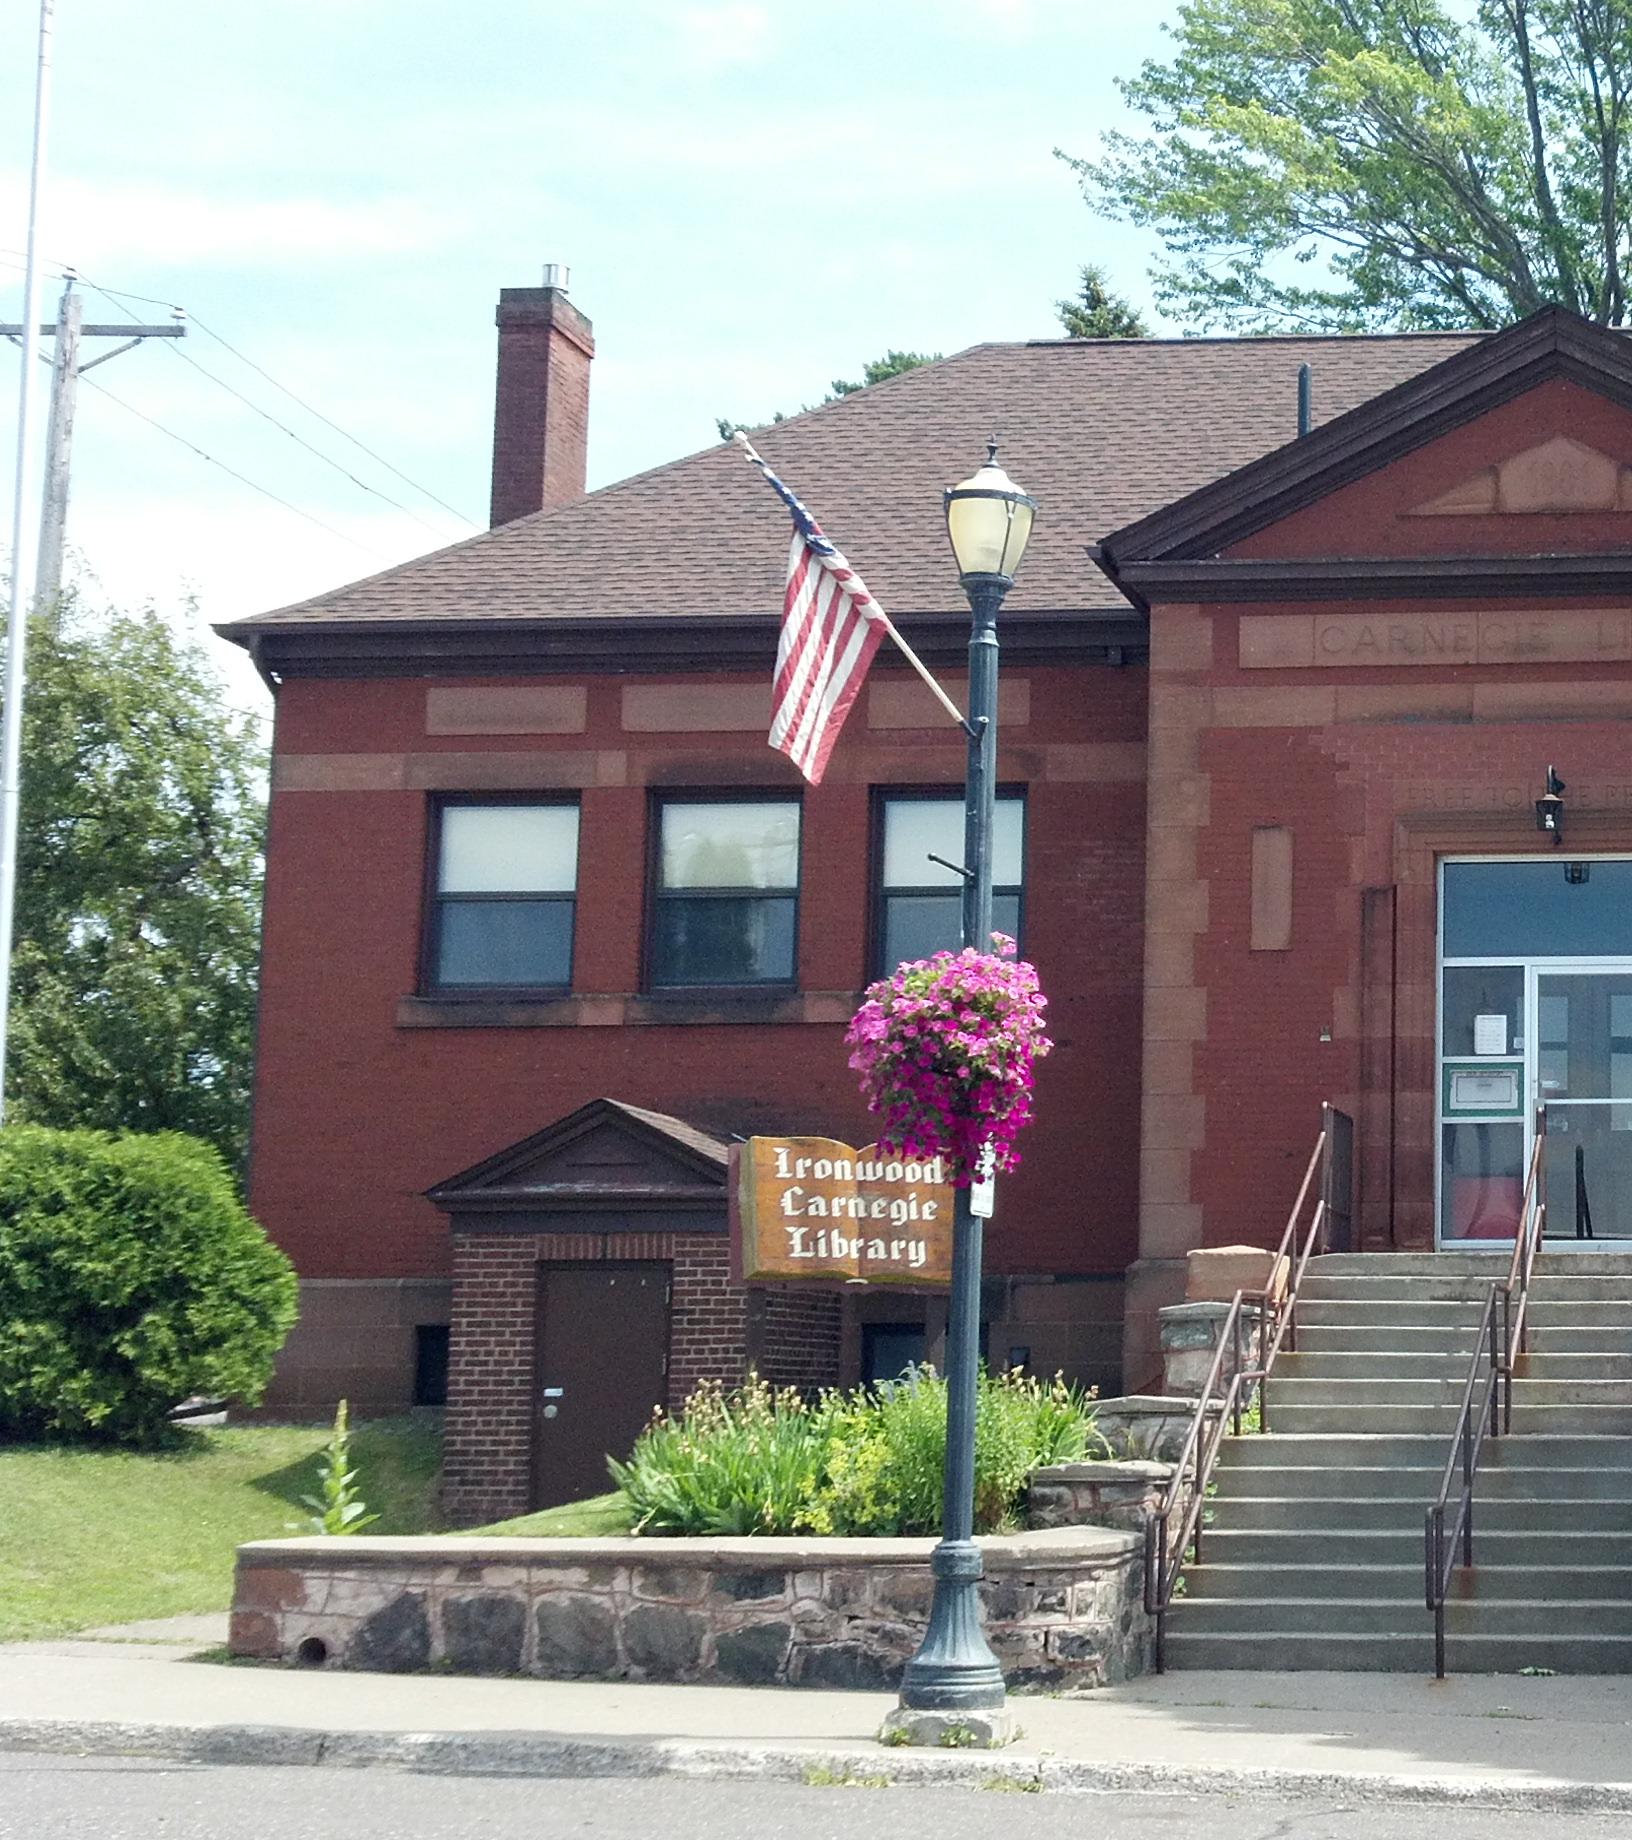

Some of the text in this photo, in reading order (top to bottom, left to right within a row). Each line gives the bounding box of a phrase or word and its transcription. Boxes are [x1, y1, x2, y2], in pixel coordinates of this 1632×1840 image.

[1319, 621, 1551, 656] CARNEGIE
[773, 1147, 945, 1184] Ironwood
[780, 1186, 939, 1226] Carnegie
[784, 1226, 927, 1268] Library
